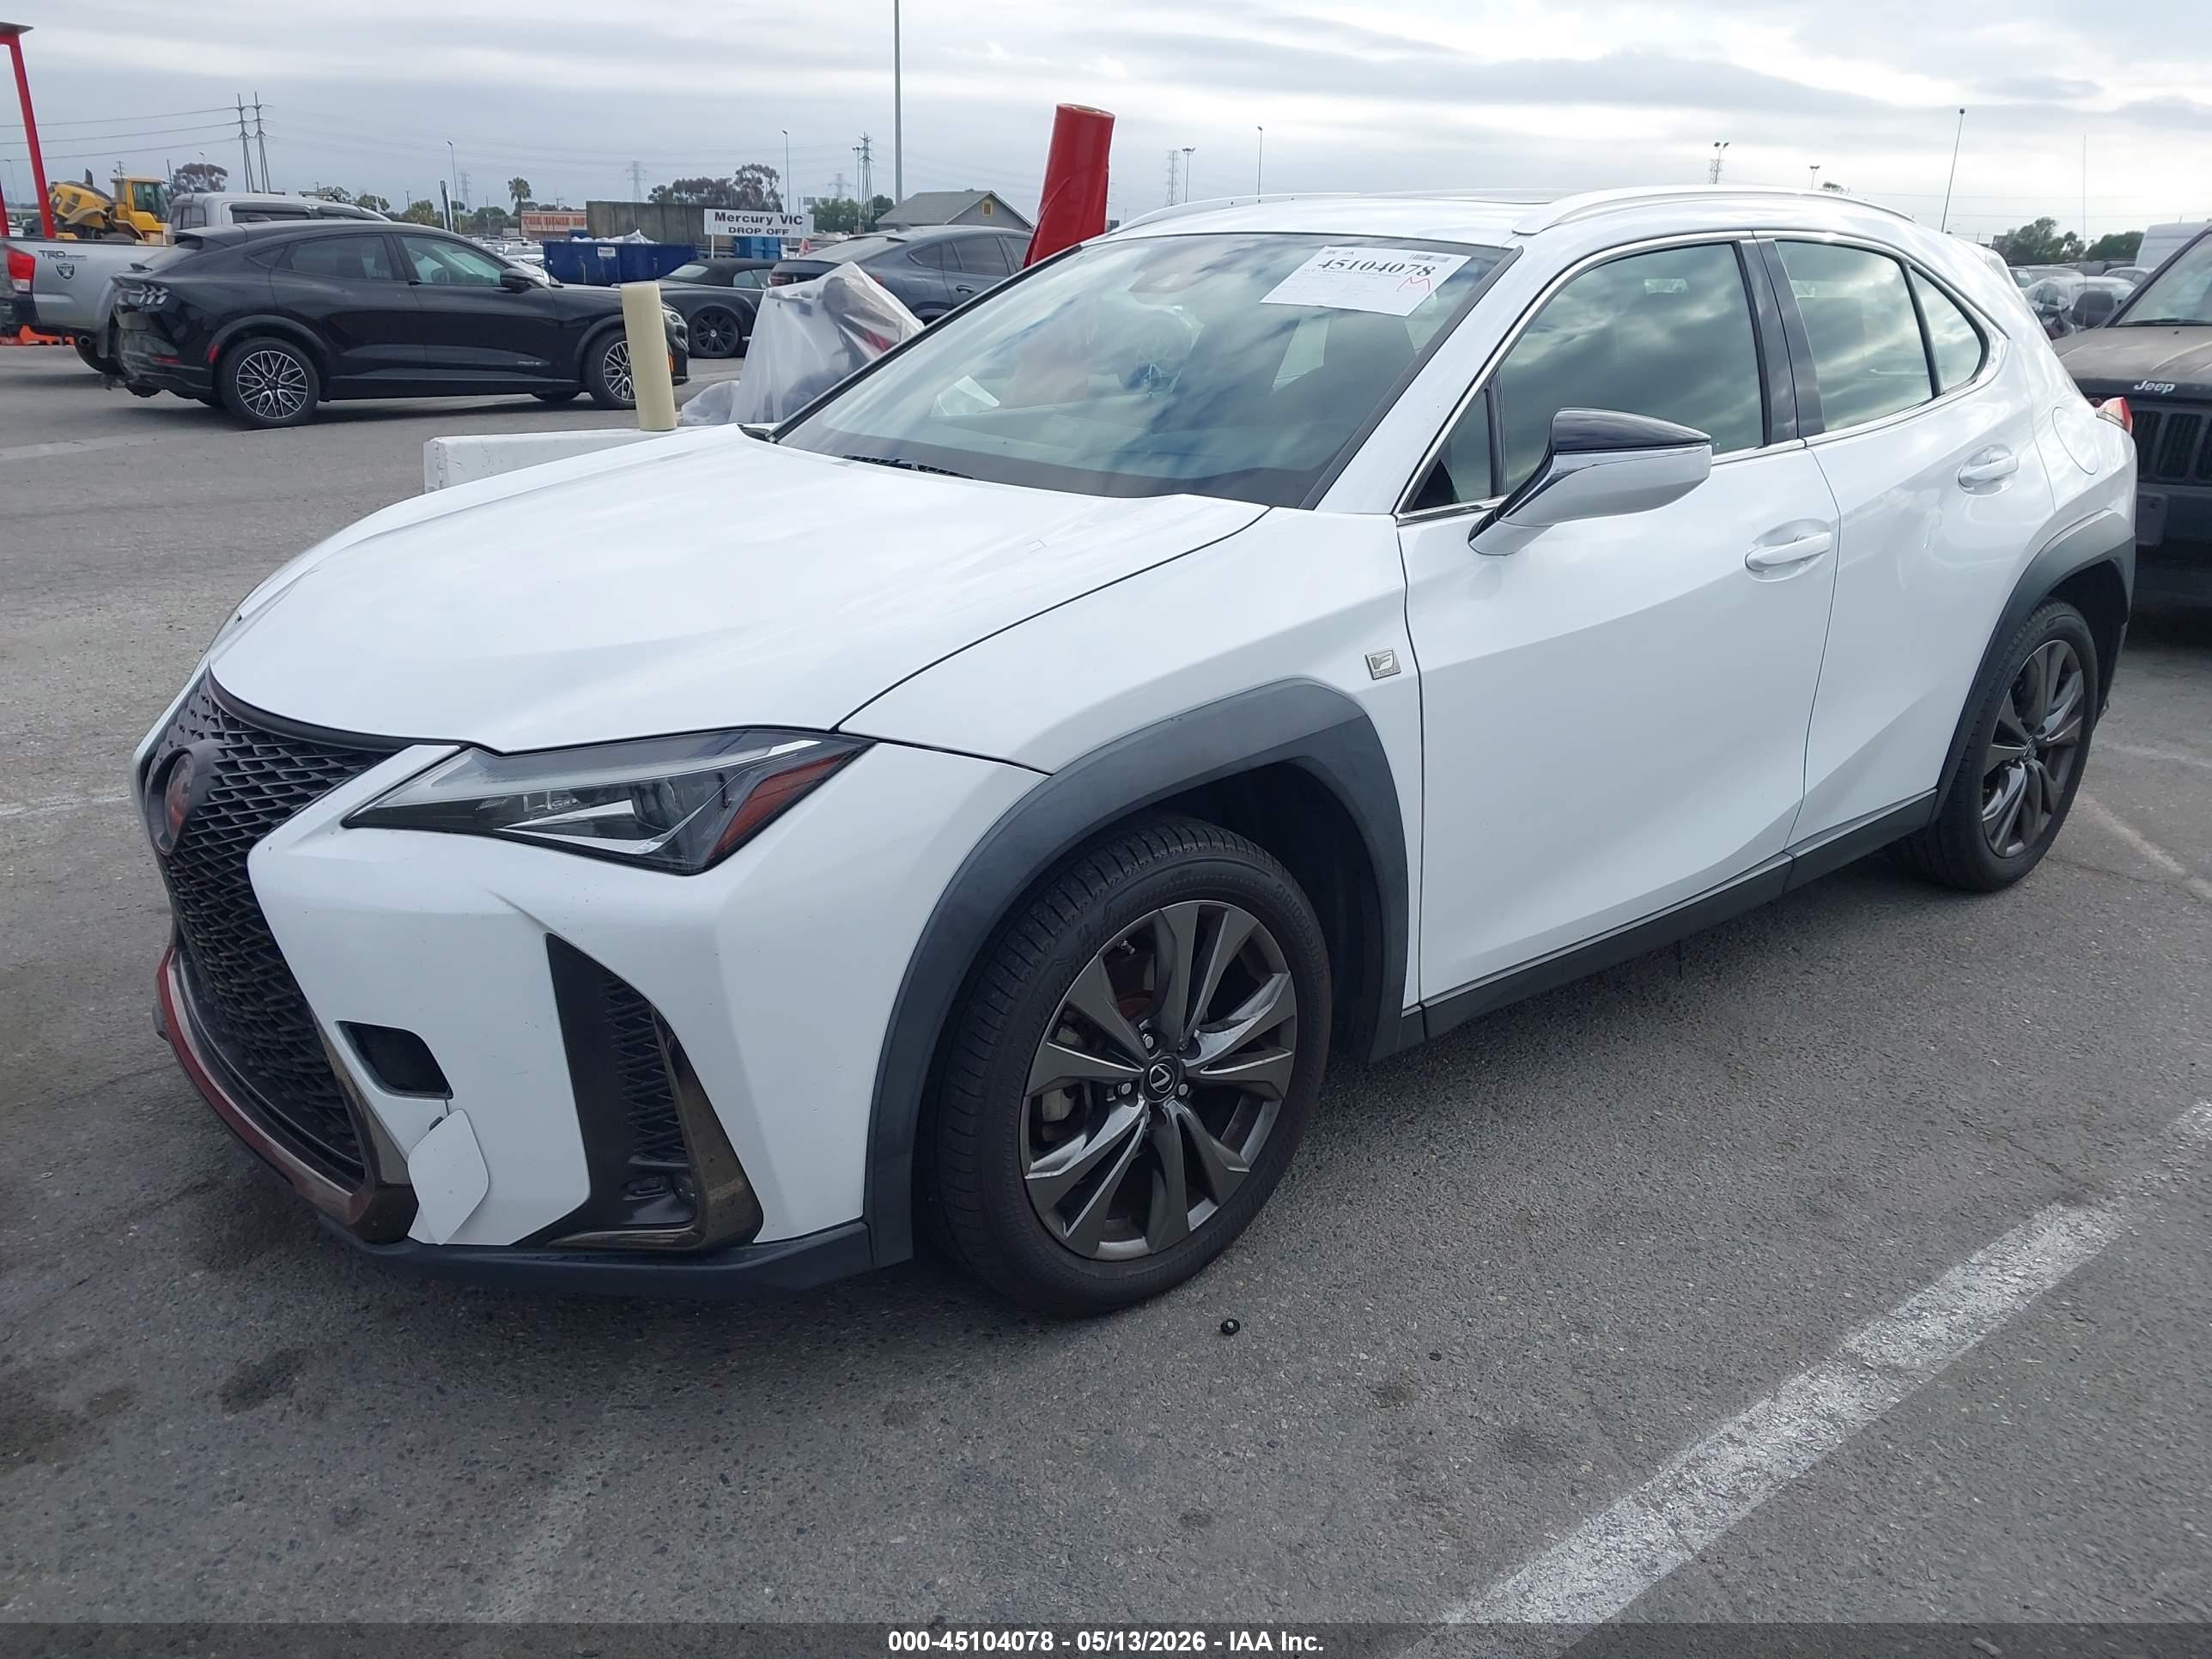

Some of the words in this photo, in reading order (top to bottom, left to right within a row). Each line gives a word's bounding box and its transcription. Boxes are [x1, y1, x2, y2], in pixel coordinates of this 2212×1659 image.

[714, 211, 774, 226] Mercury
[780, 215, 804, 225] VIC
[728, 226, 762, 234] DROP
[38, 250, 66, 259] TRD
[1317, 258, 1437, 277] 45104078
[2134, 380, 2175, 394] Jeep
